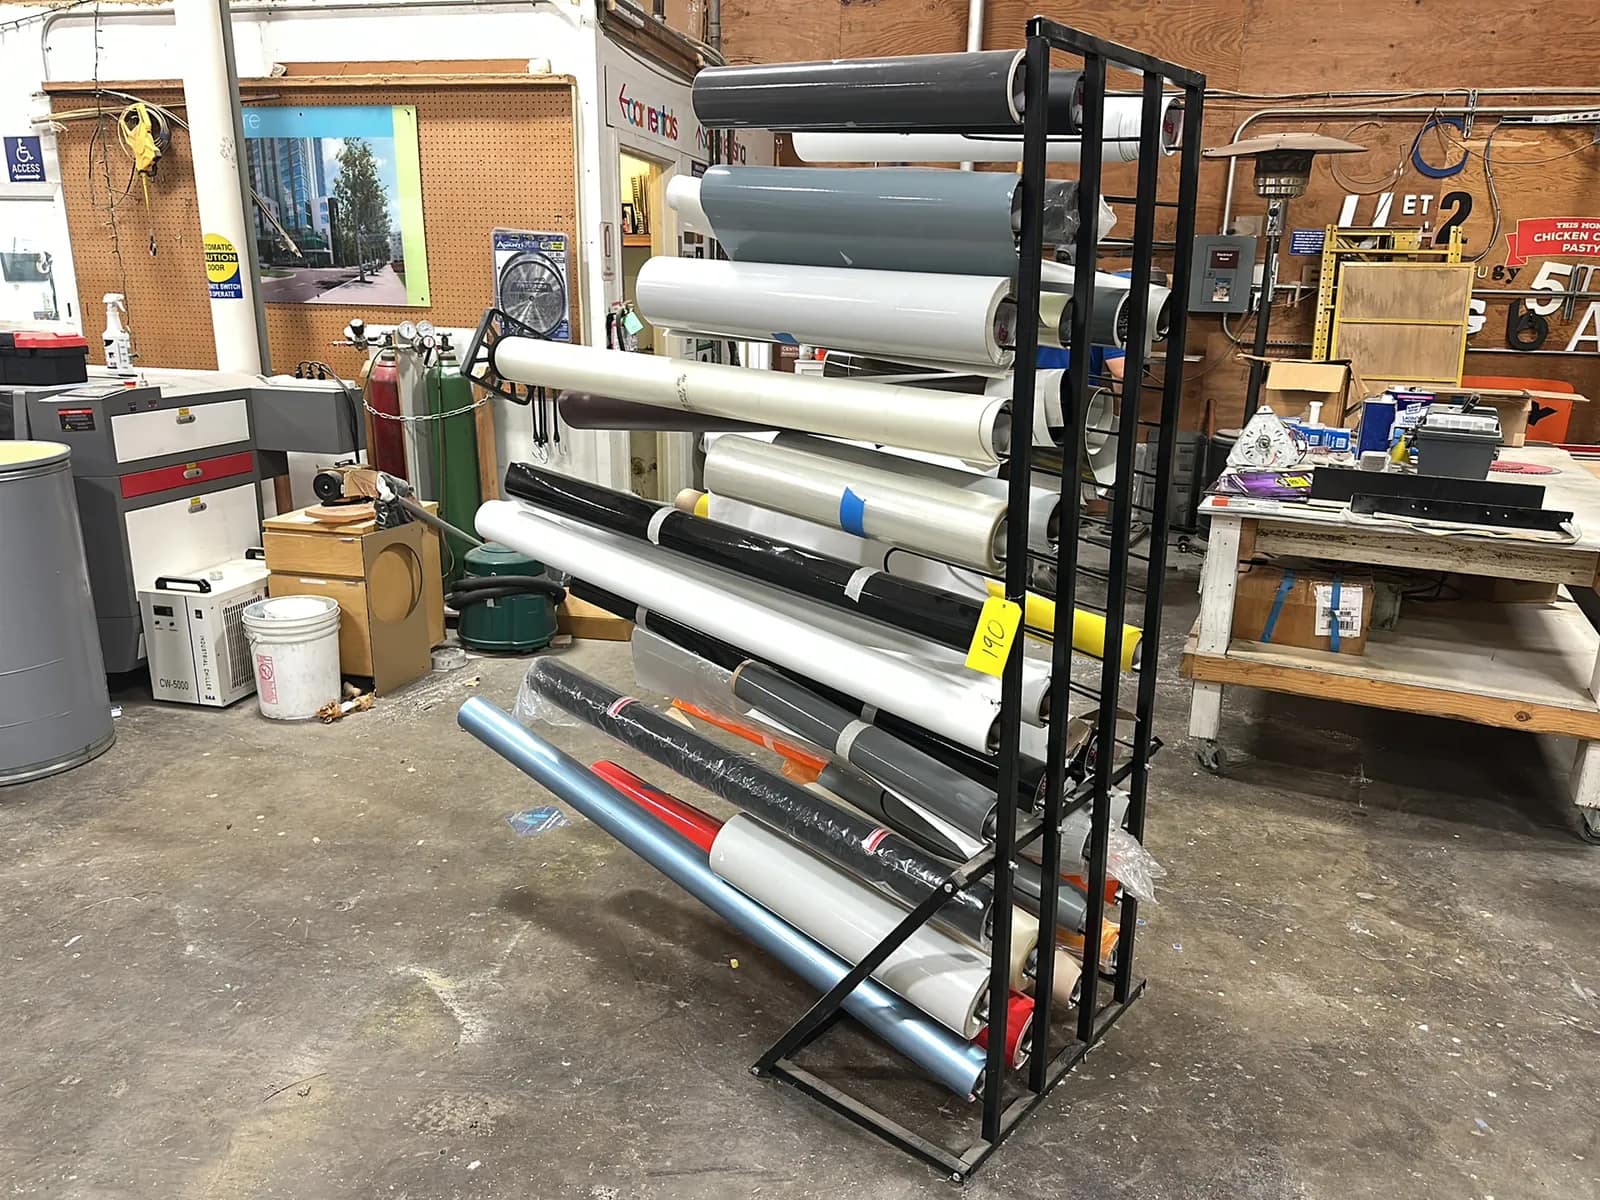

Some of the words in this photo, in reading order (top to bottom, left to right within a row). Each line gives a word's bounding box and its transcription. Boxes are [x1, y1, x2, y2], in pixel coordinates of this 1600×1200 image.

[12, 163, 41, 173] ACCESS
[1402, 194, 1434, 215] ET
[1435, 191, 1473, 245] 2
[1533, 231, 1589, 242] CHICKEN
[1561, 243, 1600, 253] PASTY
[1525, 261, 1573, 316] 5
[1507, 298, 1549, 351] 6
[982, 619, 1005, 659] 190
[159, 678, 189, 691] CW-5000
